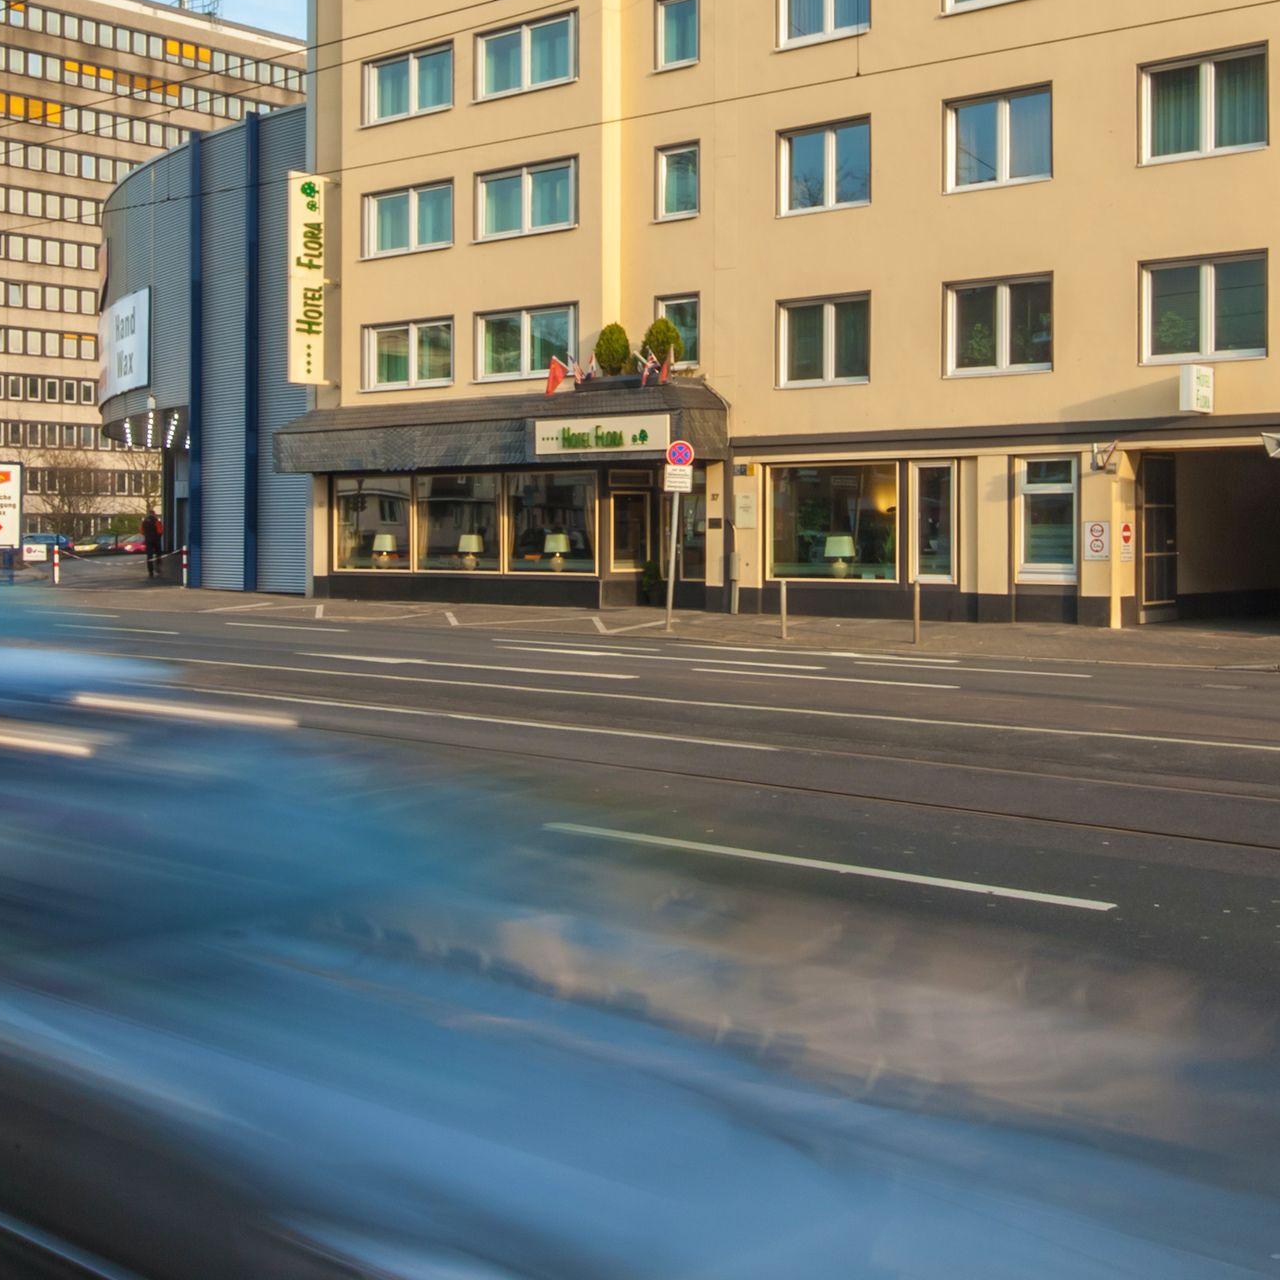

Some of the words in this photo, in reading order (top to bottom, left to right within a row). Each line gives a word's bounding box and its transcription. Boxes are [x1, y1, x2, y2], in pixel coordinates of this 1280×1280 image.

[295, 222, 323, 270] FLORA
[114, 306, 136, 342] Hand
[295, 286, 323, 336] HOTEL
[116, 351, 134, 379] Wax
[561, 426, 591, 448] HOTEL
